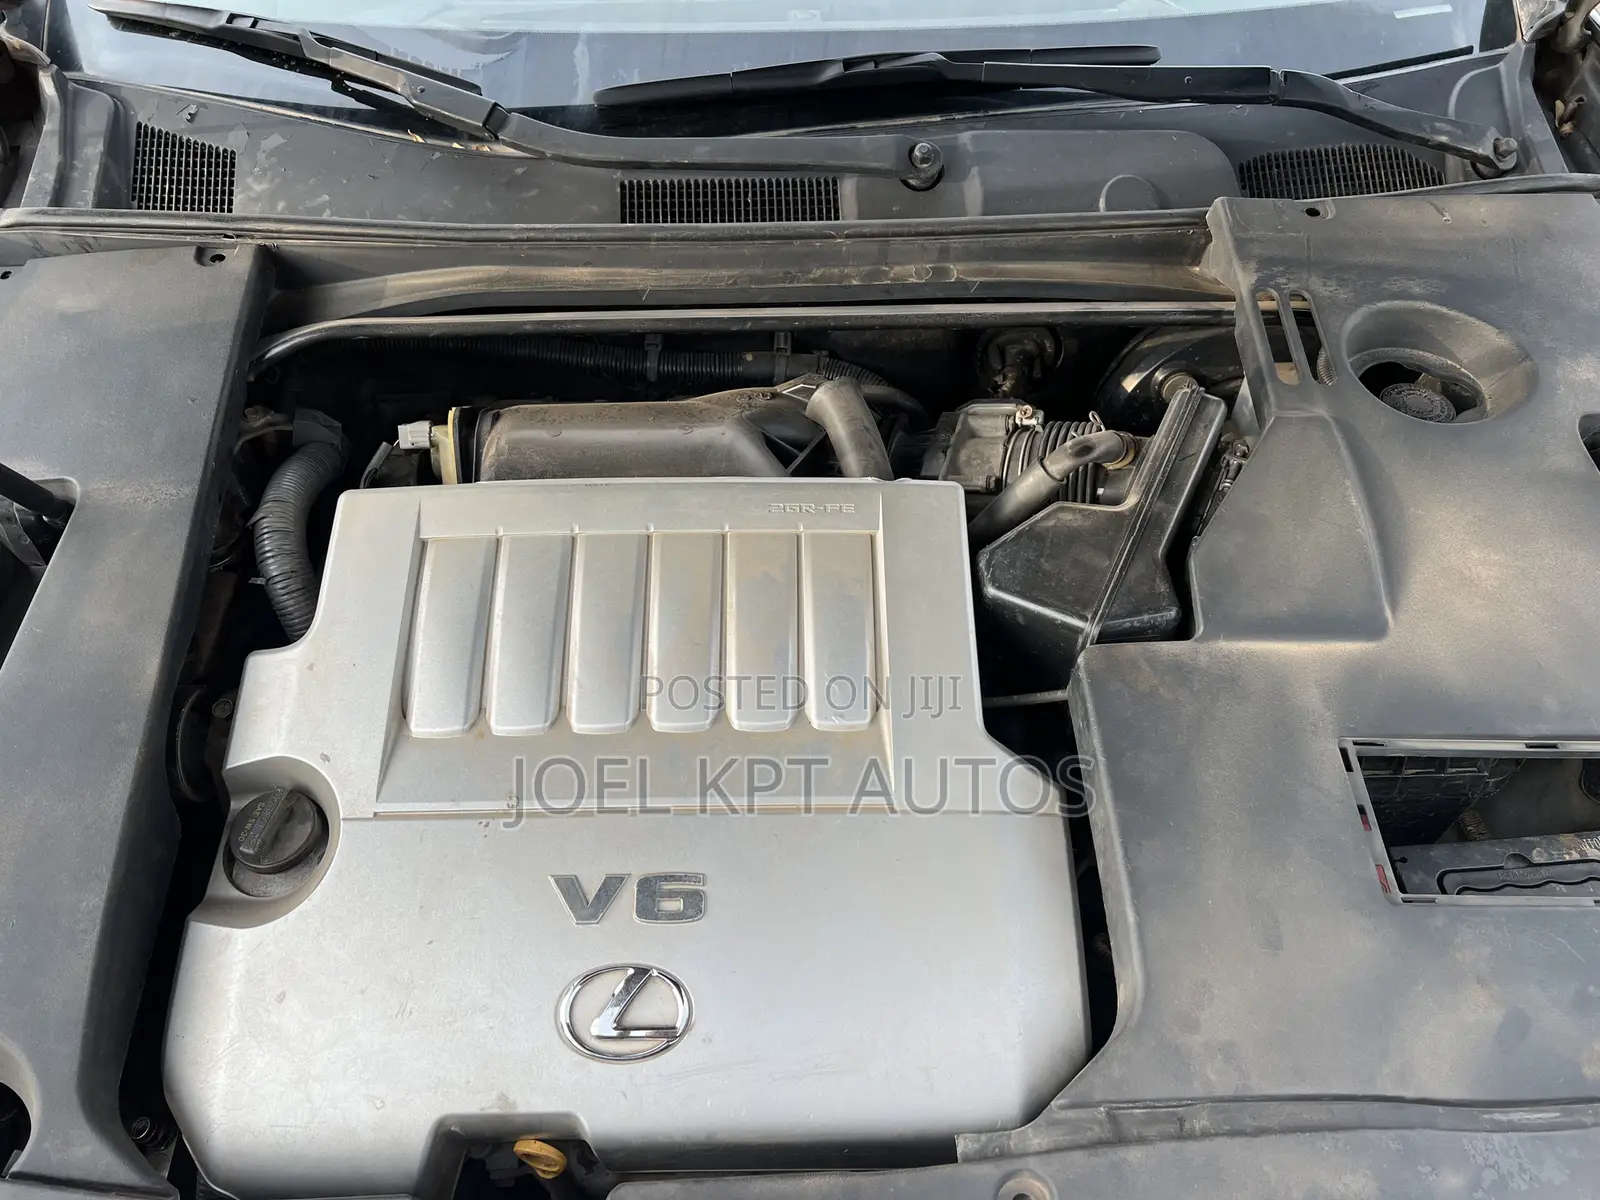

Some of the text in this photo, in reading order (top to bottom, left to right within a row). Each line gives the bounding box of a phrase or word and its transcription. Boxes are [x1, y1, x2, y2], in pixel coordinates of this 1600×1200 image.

[768, 503, 855, 513] 2GR-FE
[252, 801, 266, 817] SAE
[237, 817, 256, 842] 5W-30
[549, 872, 706, 925] V6
